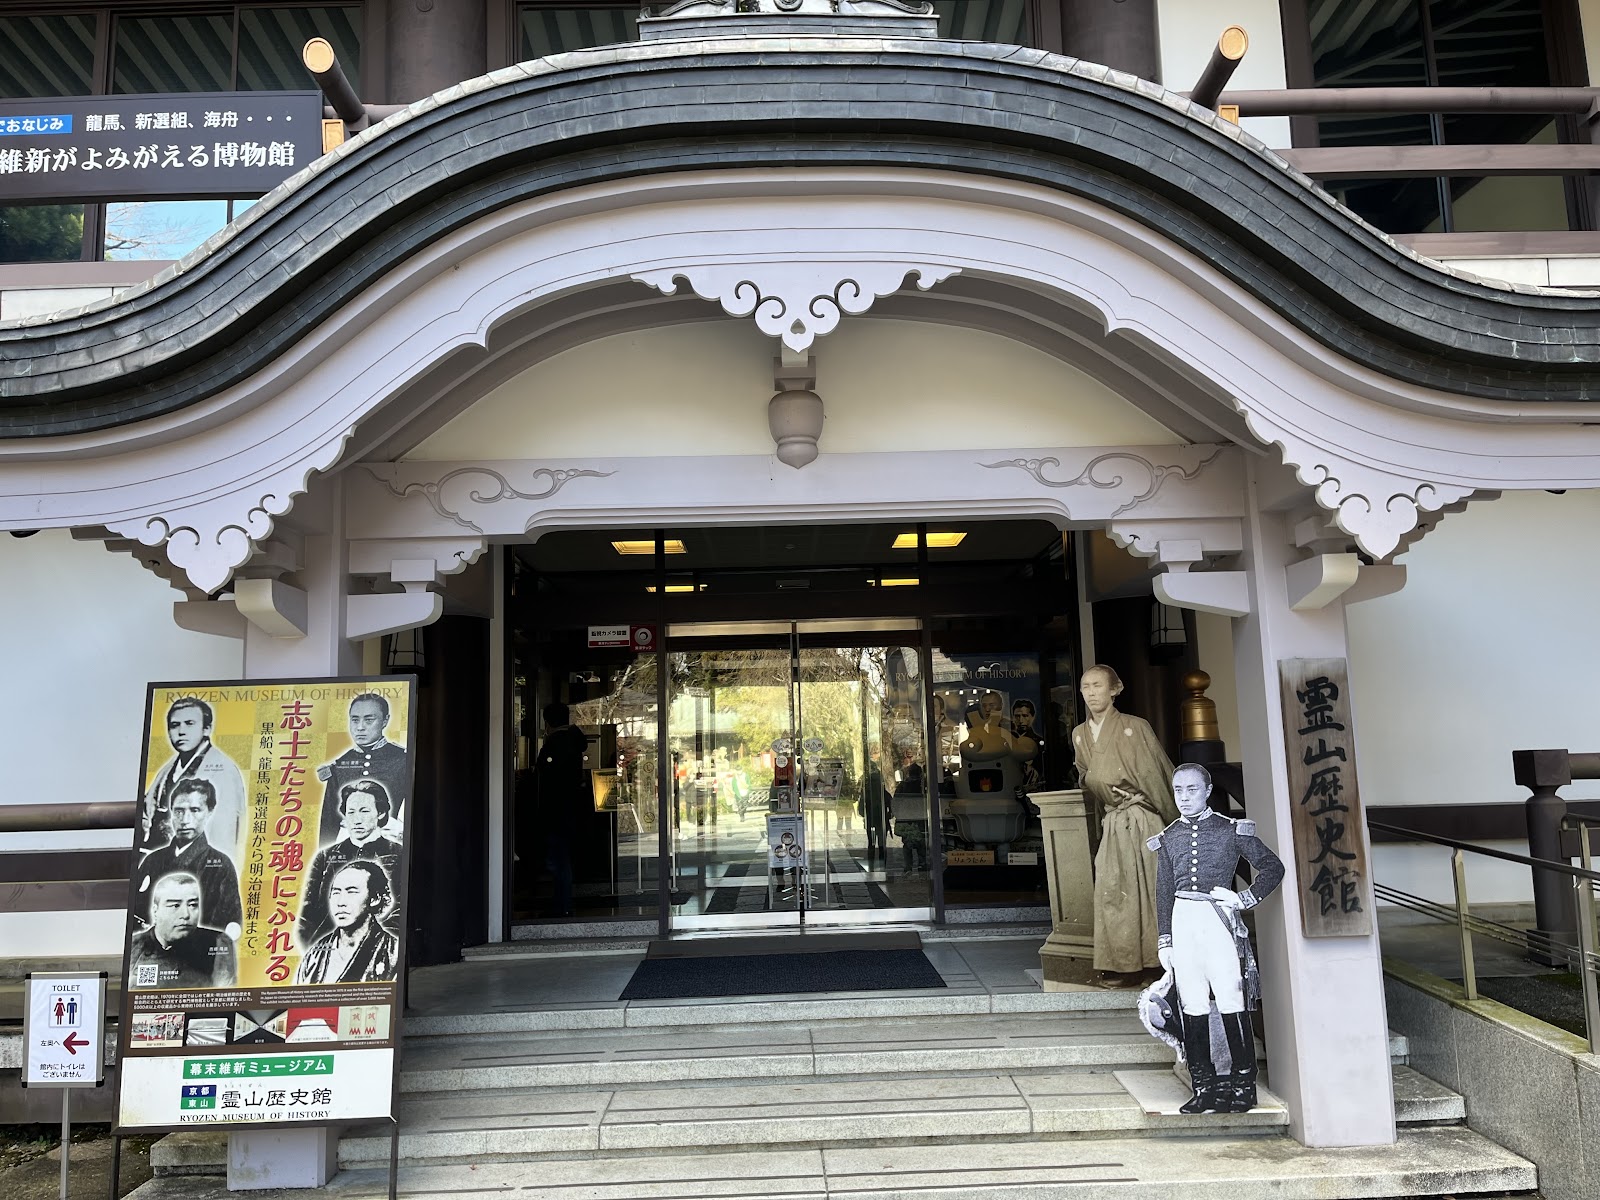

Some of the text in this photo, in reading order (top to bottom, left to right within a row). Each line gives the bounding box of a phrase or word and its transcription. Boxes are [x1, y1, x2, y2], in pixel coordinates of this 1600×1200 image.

[0, 141, 296, 174] 維新がよみがえる博物館
[975, 670, 987, 679] OF
[990, 669, 1027, 679] HISTORY
[165, 687, 402, 703] RYOZEN MUSEUM OF HISTORY
[1296, 676, 1363, 916] 霊山歴史館
[246, 722, 275, 956] 黒船、龍馬、新選組から明治維新まで。
[265, 700, 314, 982] 志士たちの魂にふれる
[190, 1059, 327, 1075] 幕末維新ミュージアム
[189, 1086, 210, 1096] 京都
[221, 1088, 332, 1109] 霊山歴史館
[188, 1098, 209, 1108] 東山
[180, 1110, 331, 1122] RYOZEN MUSEUM OF HISTORY
